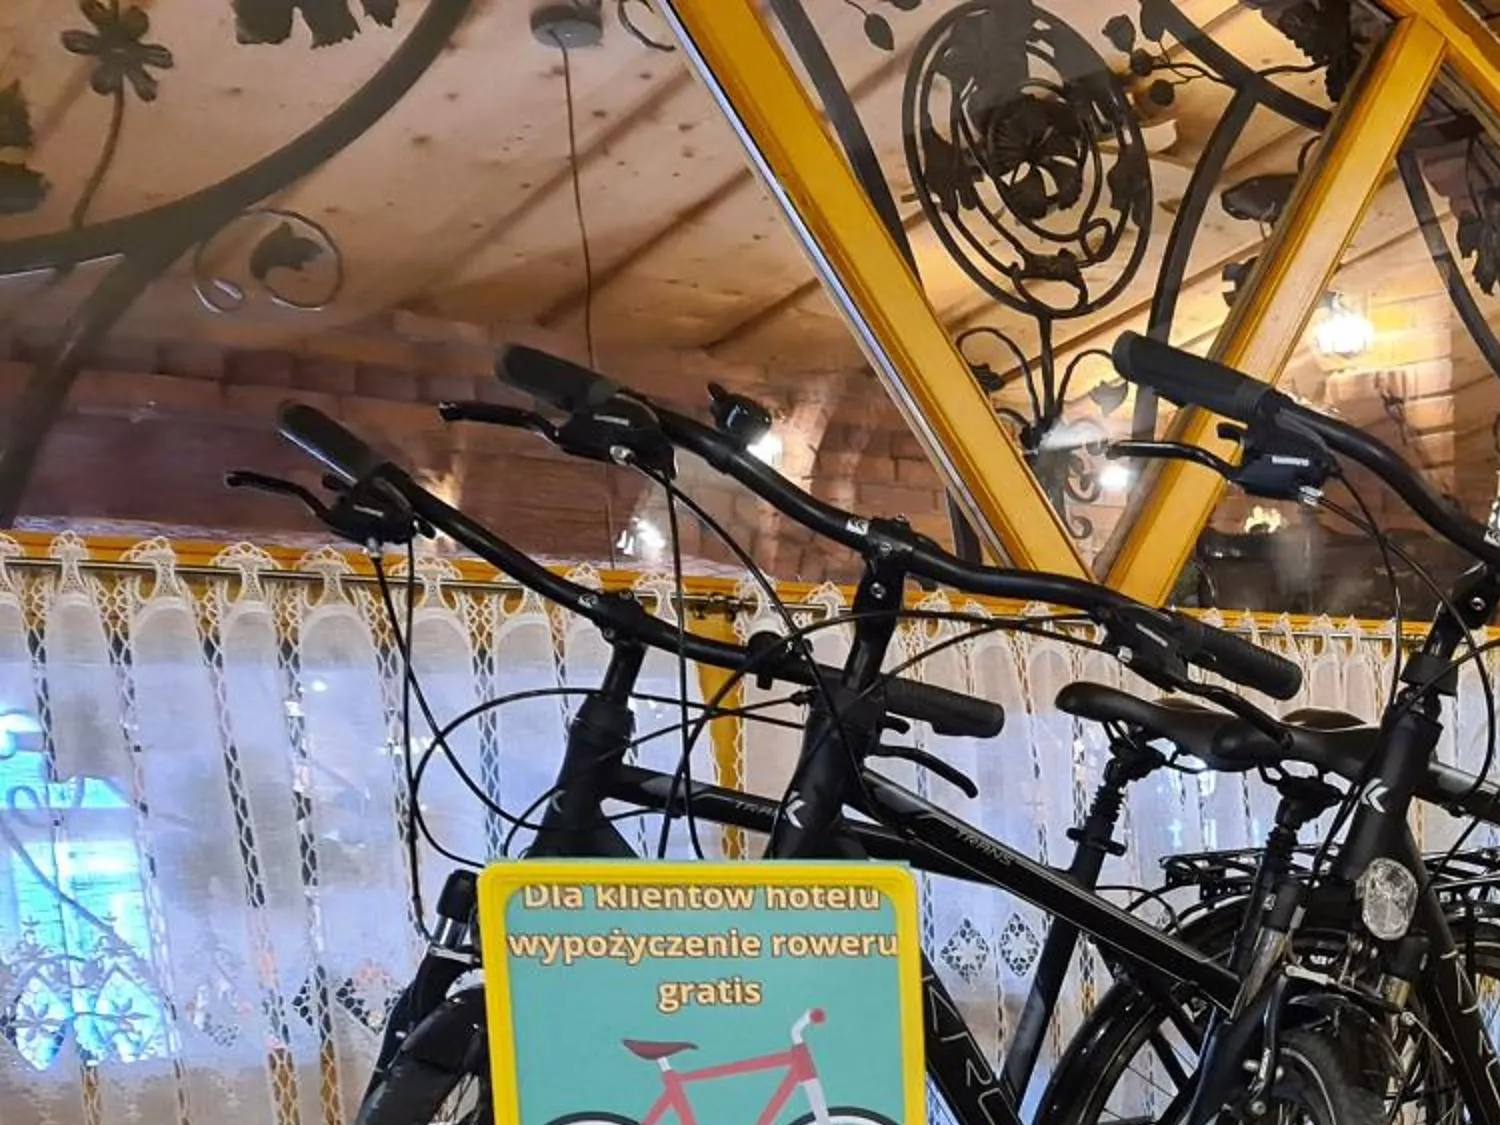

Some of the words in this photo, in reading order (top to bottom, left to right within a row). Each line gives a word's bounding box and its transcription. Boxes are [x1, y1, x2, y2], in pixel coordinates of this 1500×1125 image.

[523, 884, 584, 910] Dla
[765, 884, 882, 911] hotelu
[507, 928, 762, 967] wypożyczenie
[771, 934, 899, 958] roweru
[656, 976, 763, 1015] gratis
